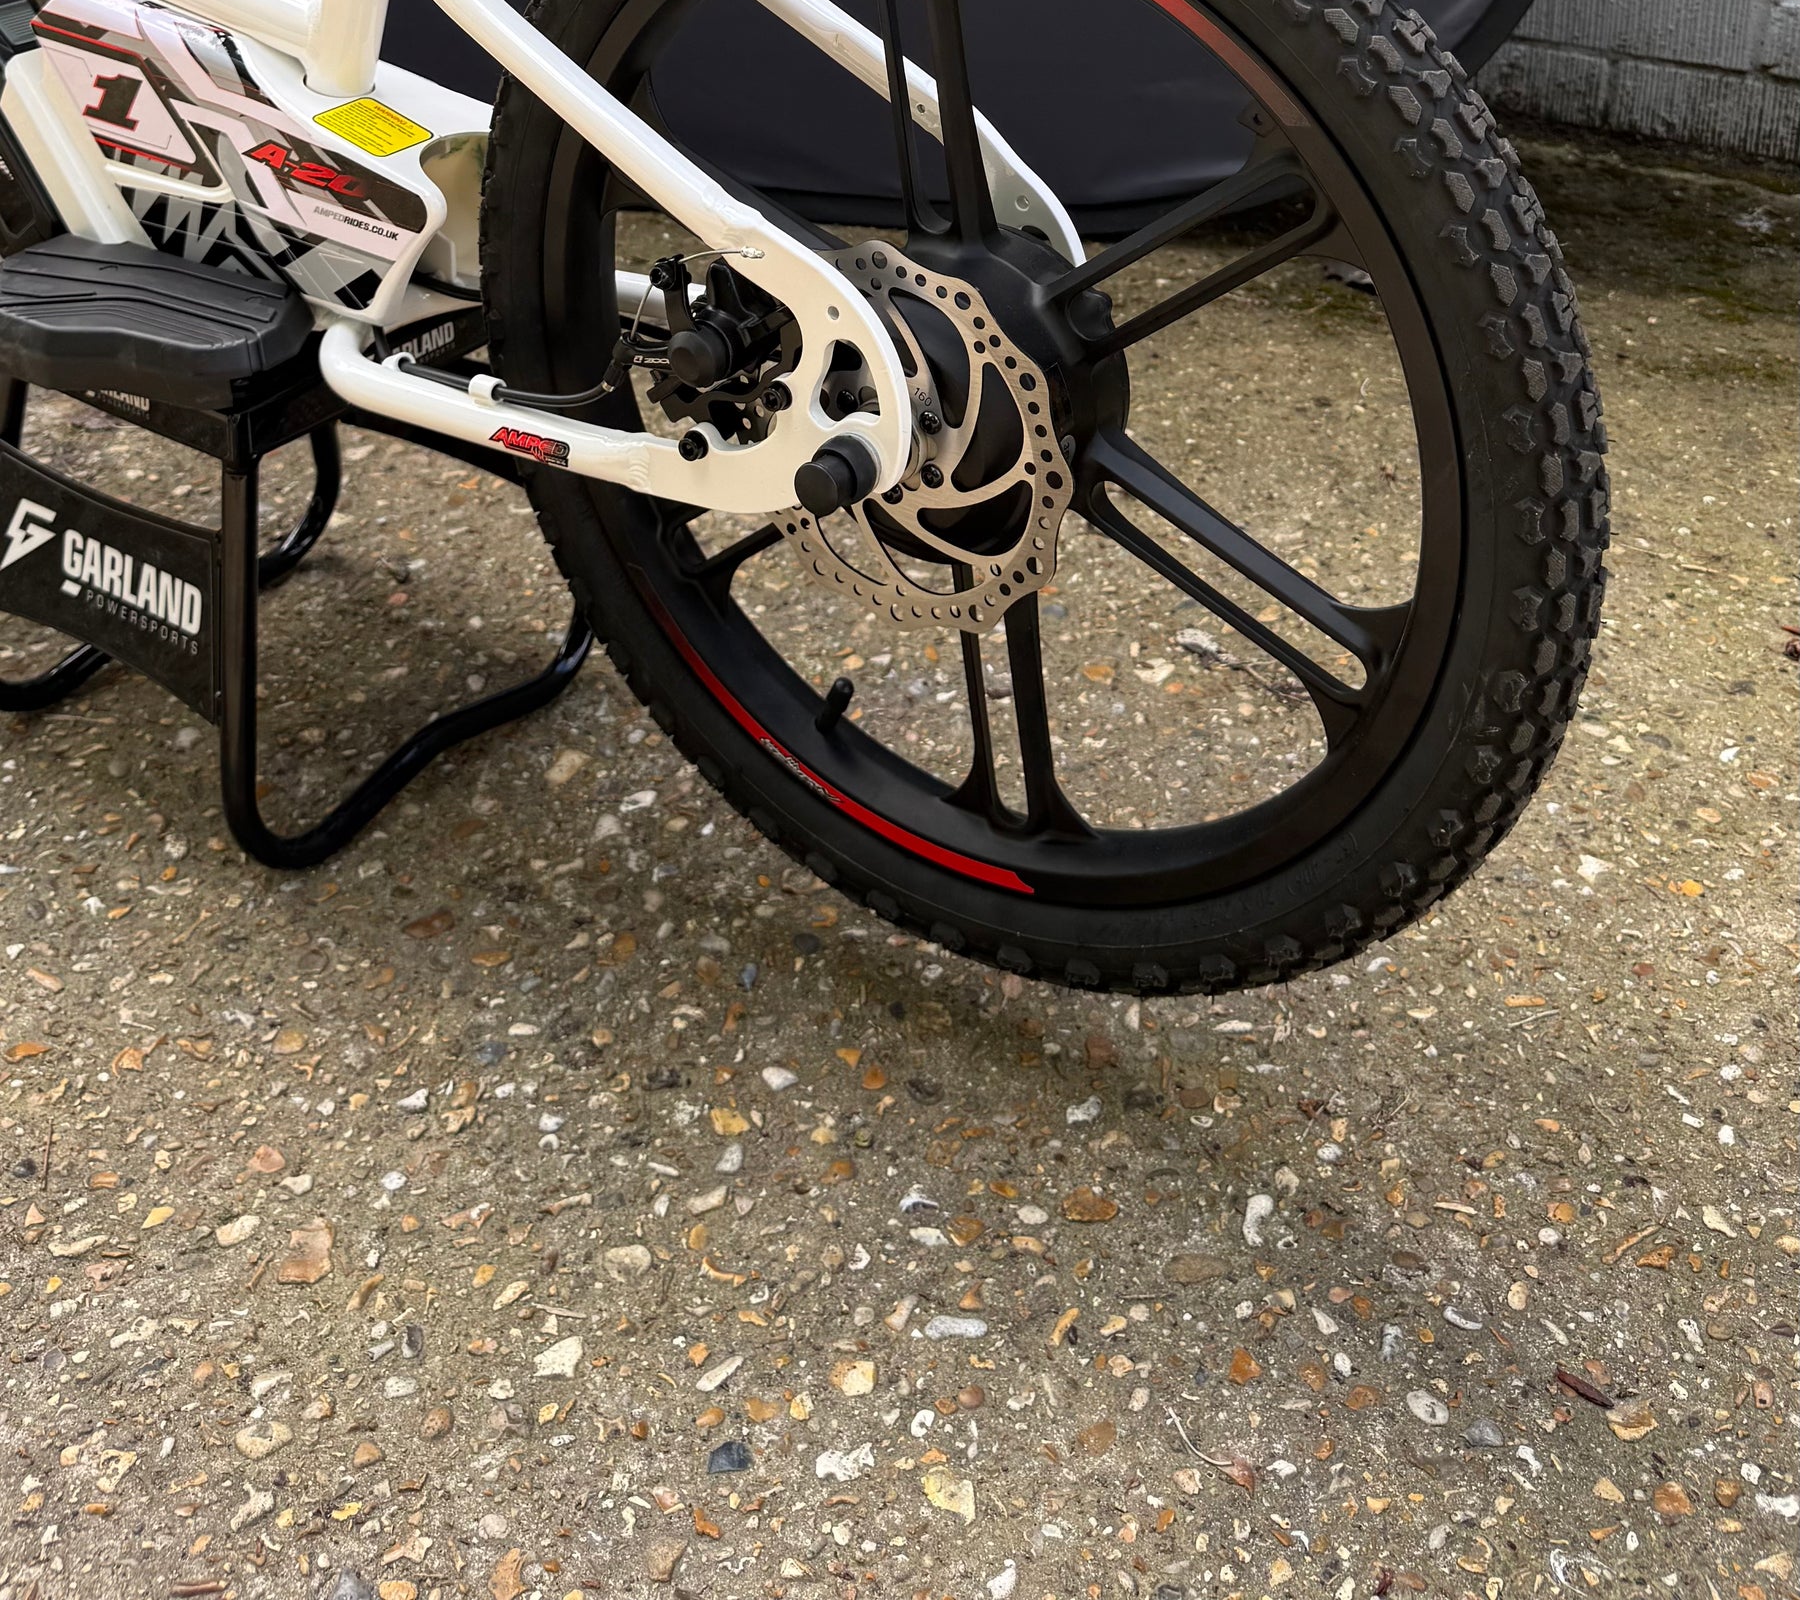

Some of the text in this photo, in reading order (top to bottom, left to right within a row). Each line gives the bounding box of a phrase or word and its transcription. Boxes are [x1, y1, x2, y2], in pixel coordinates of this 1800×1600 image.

[82, 73, 143, 132] 1
[313, 205, 400, 241] AMPEDRIDES.CO.UK
[914, 387, 932, 406] 160
[490, 427, 570, 462] AMPED
[62, 528, 202, 635] GARLAND
[85, 589, 199, 656] POWERSPORTS
